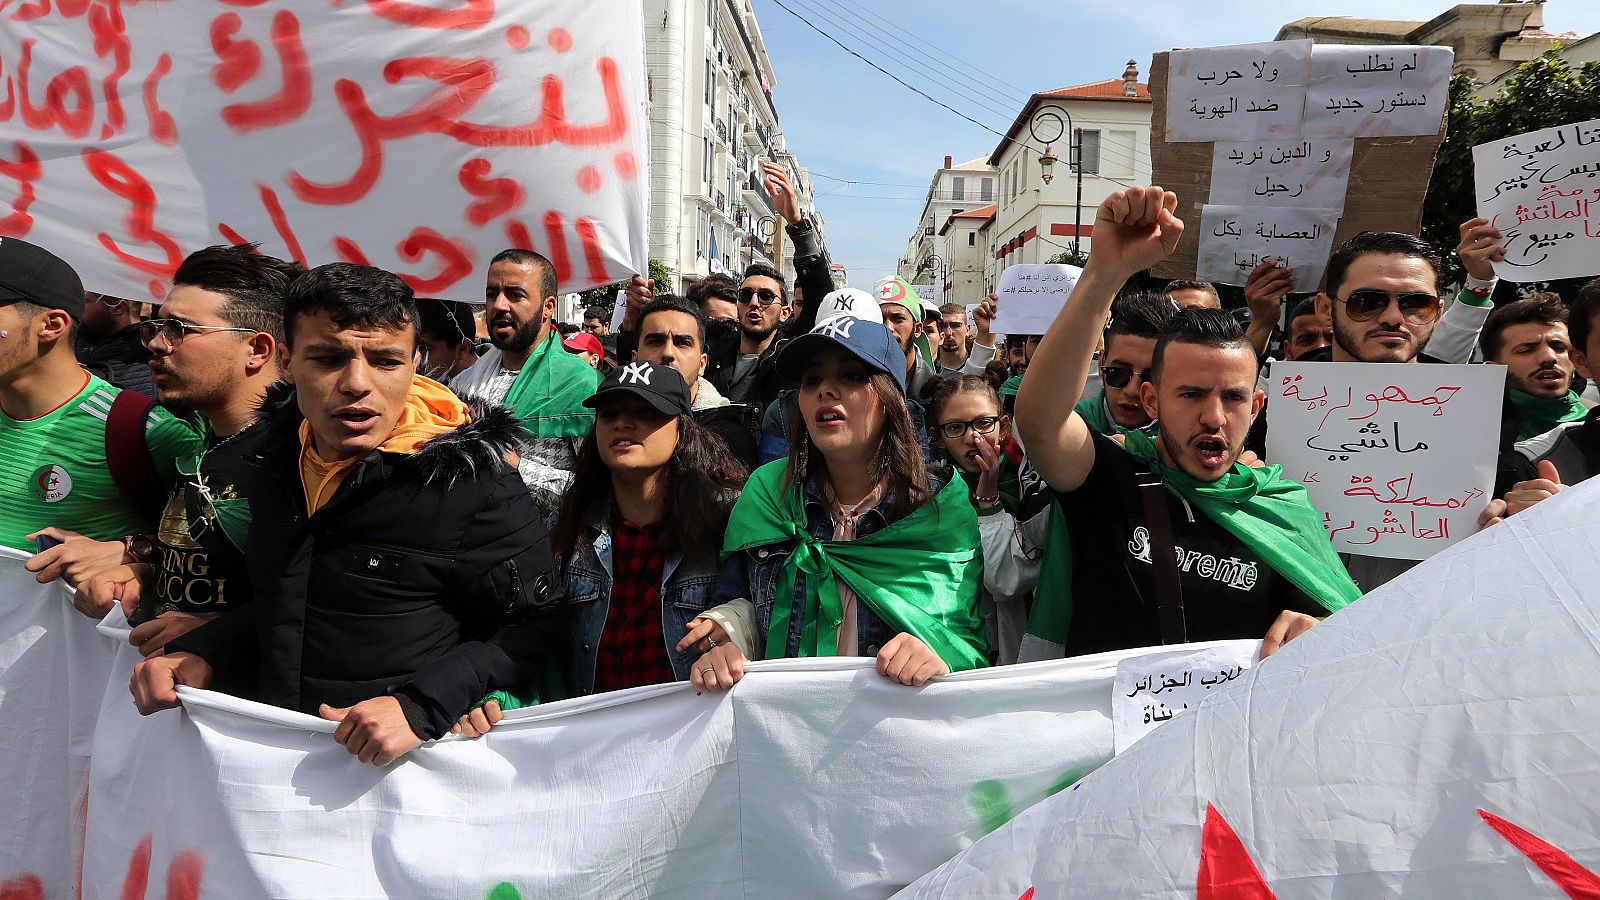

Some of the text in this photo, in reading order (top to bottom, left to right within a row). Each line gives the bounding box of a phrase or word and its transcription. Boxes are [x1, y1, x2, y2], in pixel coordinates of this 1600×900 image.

[1196, 60, 1279, 86] ولا حرب
[1346, 53, 1418, 79] لم نطلب
[1189, 96, 1280, 120] ضد الهوية
[1325, 91, 1427, 116] دستور جديد
[1228, 146, 1264, 166] نريد
[1254, 176, 1303, 197] رحيل
[1213, 219, 1322, 242] العصابة بكل
[618, 361, 654, 386] NY
[1281, 374, 1463, 432] جمهورية
[1305, 421, 1430, 462] ماشي
[1126, 670, 1193, 698] الجزائر
